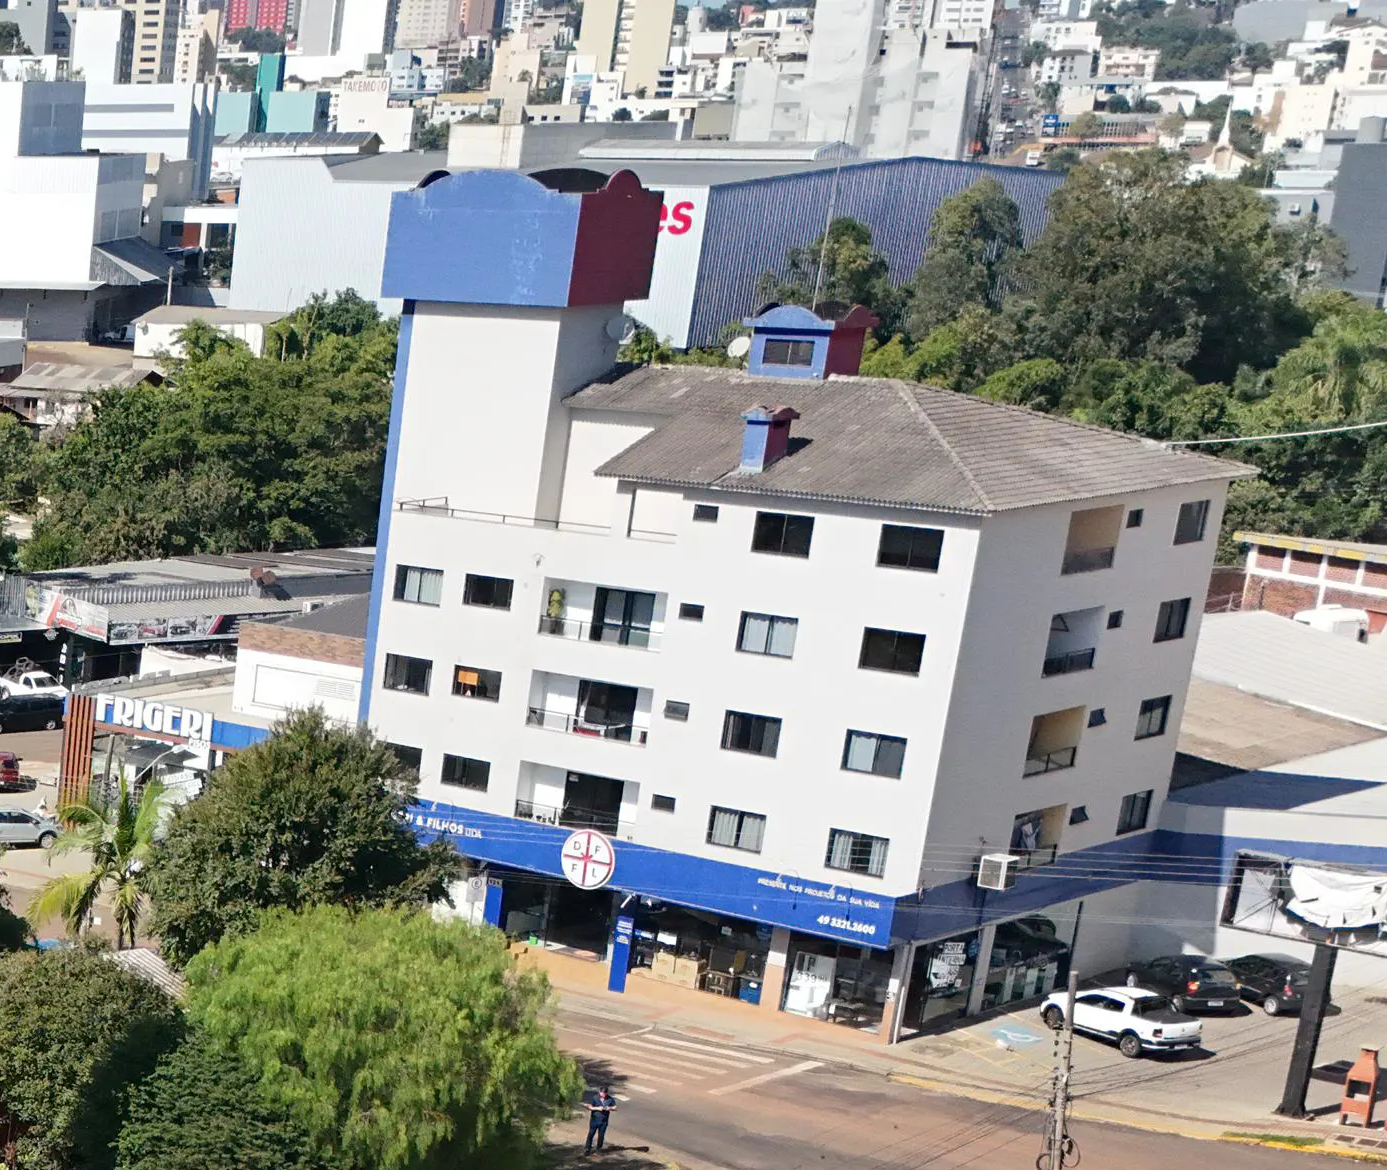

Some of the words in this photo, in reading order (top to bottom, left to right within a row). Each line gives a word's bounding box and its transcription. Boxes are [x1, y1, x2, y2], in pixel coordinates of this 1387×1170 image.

[343, 80, 387, 93] TAKEMOTO
[95, 693, 214, 742] FRIGERI
[426, 817, 464, 834] FILHOS
[573, 840, 582, 851] D
[594, 845, 602, 855] F
[571, 863, 578, 873] F
[591, 867, 597, 878] L
[836, 894, 847, 902] DA
[849, 897, 863, 906] SUA
[816, 914, 830, 926] 49
